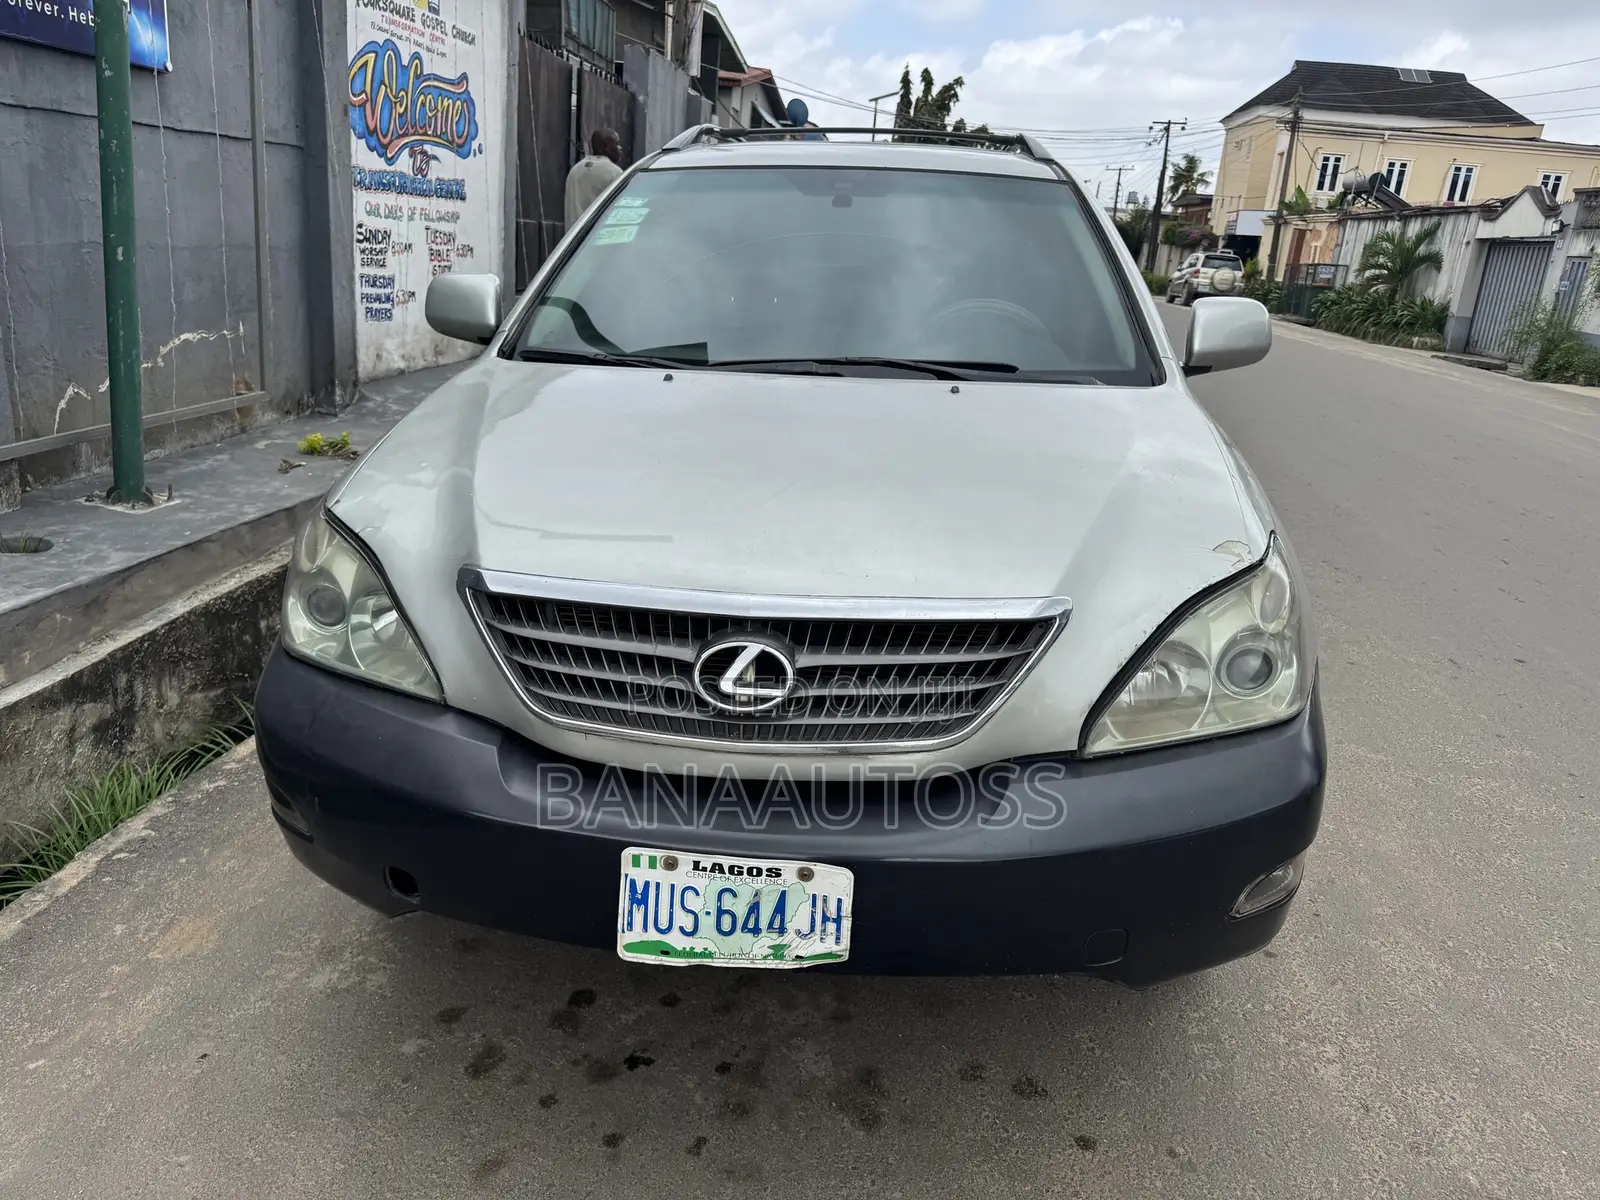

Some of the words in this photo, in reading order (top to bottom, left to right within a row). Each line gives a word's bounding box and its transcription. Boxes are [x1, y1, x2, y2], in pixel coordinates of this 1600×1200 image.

[420, 12, 448, 37] GOSPEL
[451, 24, 476, 46] CHURCH
[349, 48, 472, 160] Welcome
[351, 166, 434, 198] TRANSFORMATION
[434, 176, 467, 202] CENTRE
[364, 200, 382, 218] OUR
[383, 203, 404, 222] DAYS
[406, 207, 418, 222] OF
[419, 208, 461, 225] FELLOWSHIP
[355, 222, 392, 248] SUNDAY
[424, 225, 456, 250] TUESDAY
[357, 245, 389, 257] WORSHIP
[429, 247, 453, 263] BIBLE
[360, 257, 388, 269] SERVICE
[358, 273, 396, 291] THURSDAY
[360, 291, 396, 310] PREVAILING
[364, 306, 394, 322] PRAYERS
[685, 870, 720, 881] CENTRE
[720, 875, 733, 883] OF
[734, 876, 788, 886] EXCELLENCE
[692, 860, 783, 879] LAGOS
